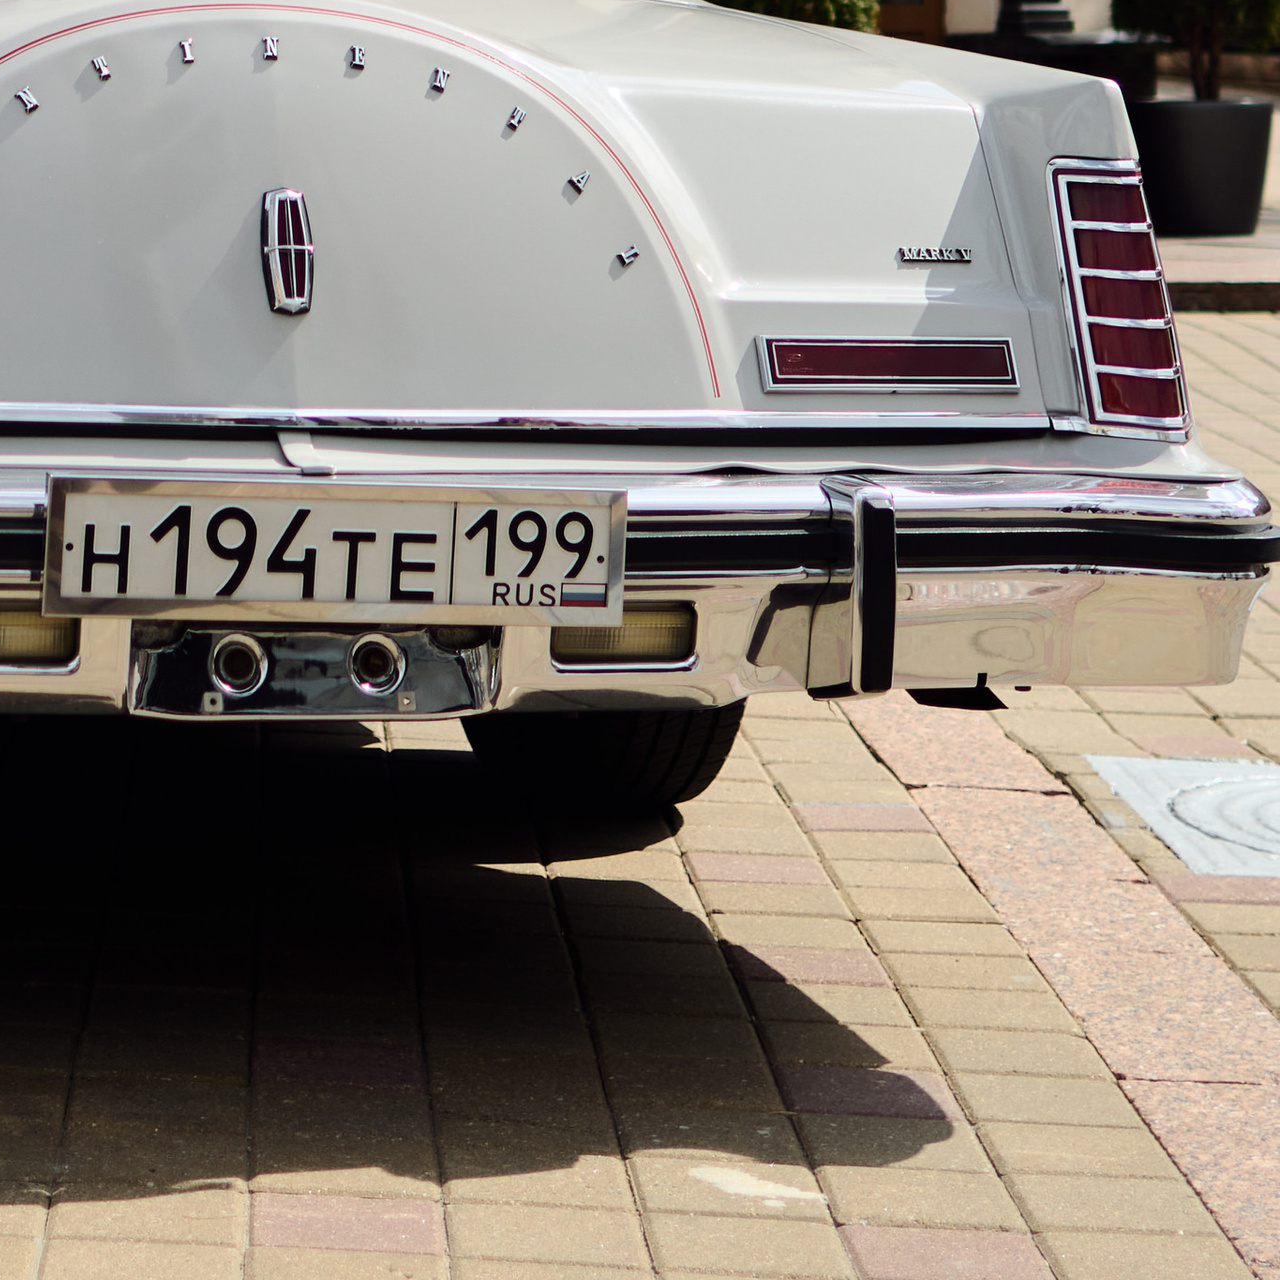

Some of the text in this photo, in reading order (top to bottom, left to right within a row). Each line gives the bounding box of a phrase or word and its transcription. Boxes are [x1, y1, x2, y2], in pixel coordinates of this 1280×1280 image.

[900, 246, 972, 263] MARK V
[464, 508, 595, 578] 199
[492, 582, 556, 608] RUS
